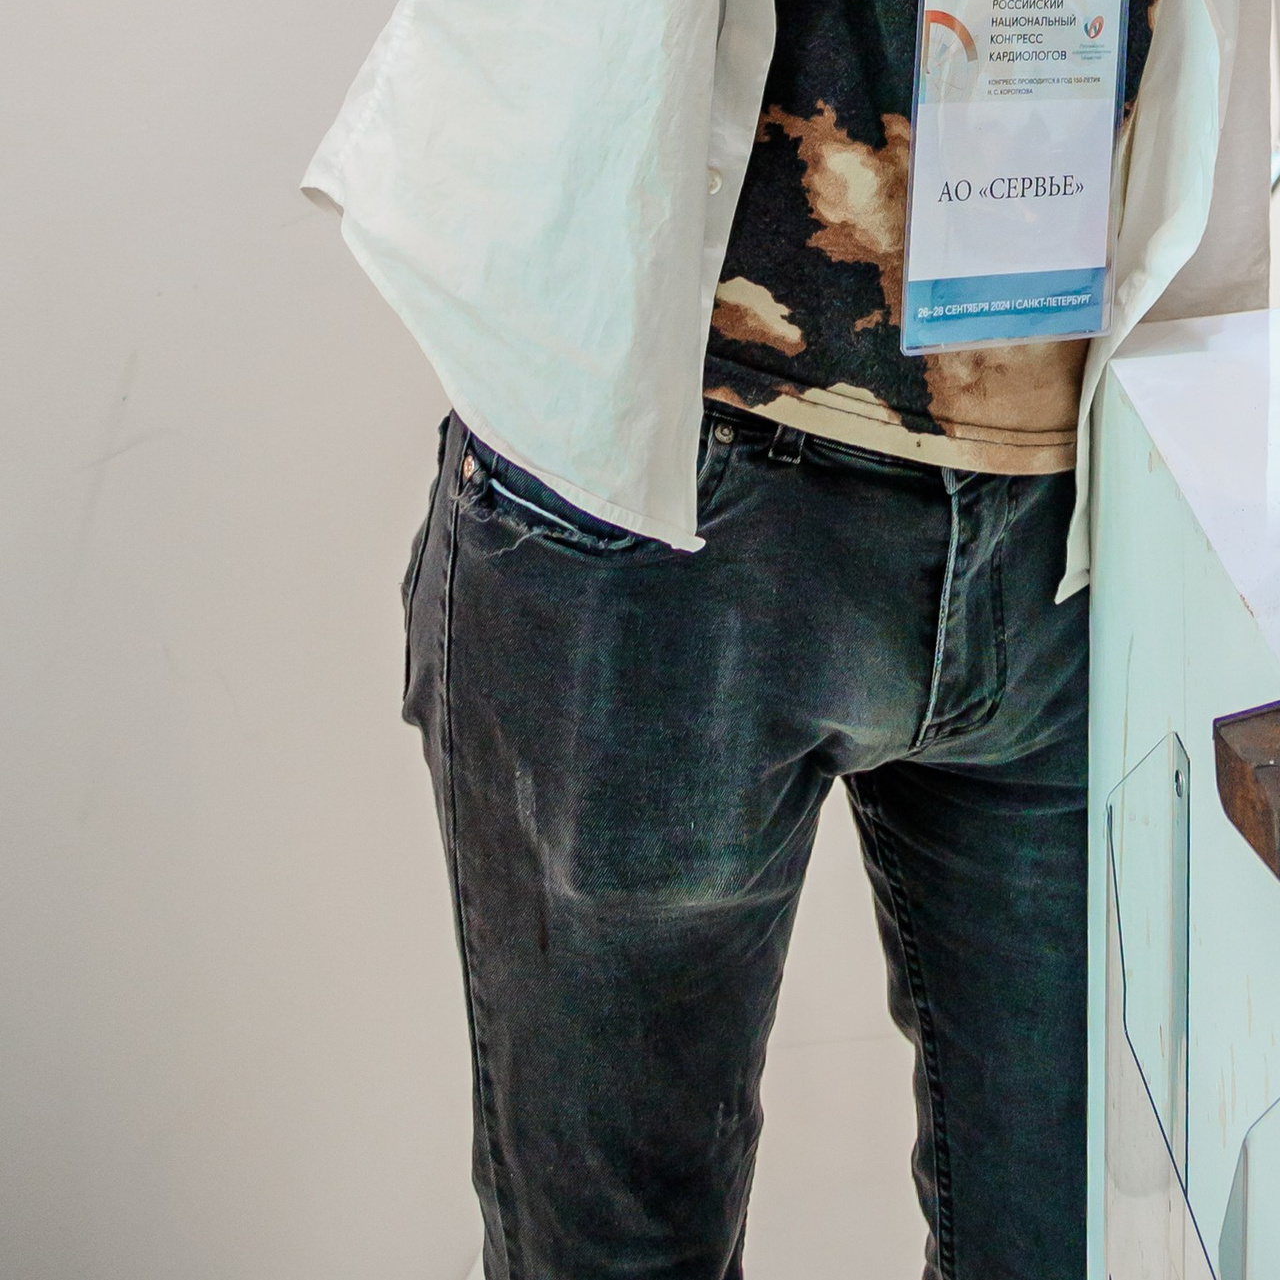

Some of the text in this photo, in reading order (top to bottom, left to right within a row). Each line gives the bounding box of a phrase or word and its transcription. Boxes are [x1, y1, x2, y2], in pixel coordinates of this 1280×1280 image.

[991, 14, 1077, 28] НАЦИОНАЛЬНЫЙ
[990, 33, 1043, 45] КОНГРЕСС
[988, 50, 1067, 63] КАРДИОЛОГОВ
[938, 175, 1084, 202] АО «СЕРВЬЕ»
[945, 302, 989, 315] СЕНТЯБРЯ
[990, 300, 1010, 311] 2024
[1016, 294, 1092, 309] САНКТ-ПЕТЕРБУРГ
